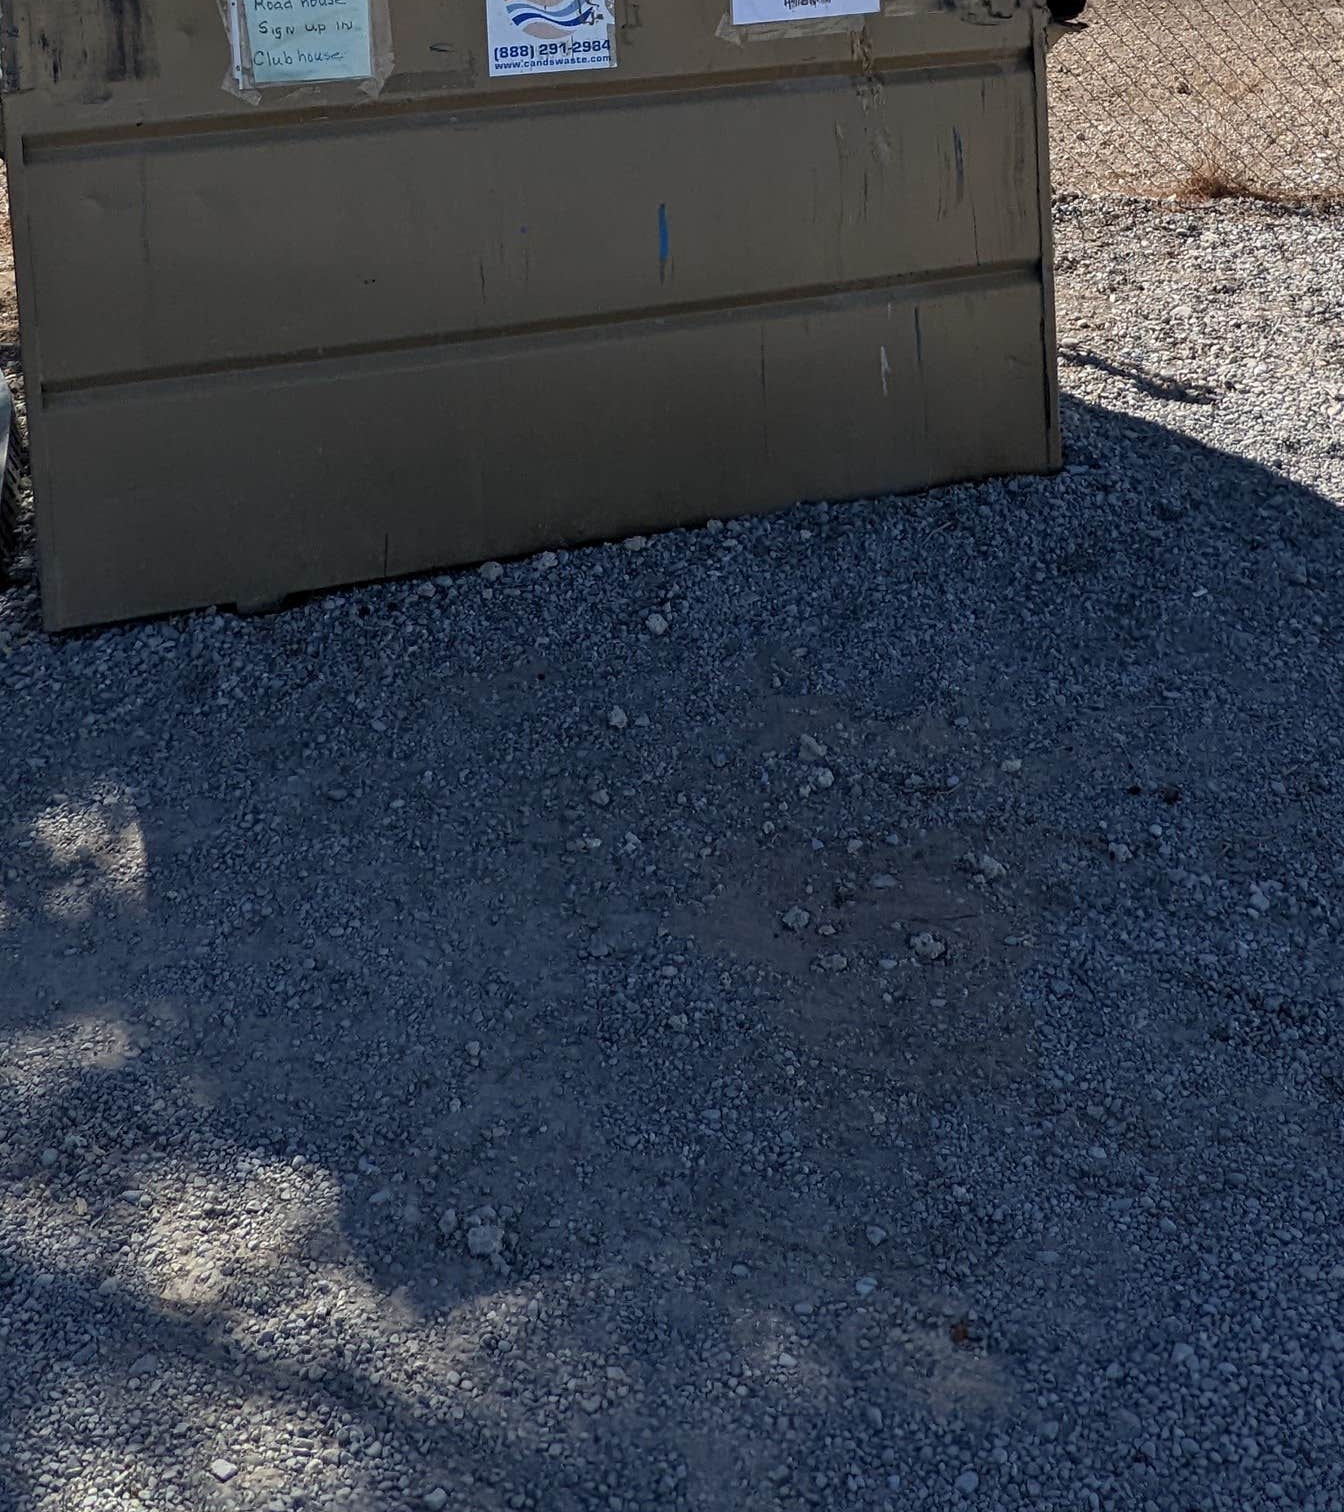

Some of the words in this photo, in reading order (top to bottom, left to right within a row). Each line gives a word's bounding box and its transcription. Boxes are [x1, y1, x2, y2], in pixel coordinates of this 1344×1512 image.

[493, 43, 535, 62] (888)
[539, 39, 611, 56] 291-2984
[494, 54, 612, 70] www.candswaste.com
